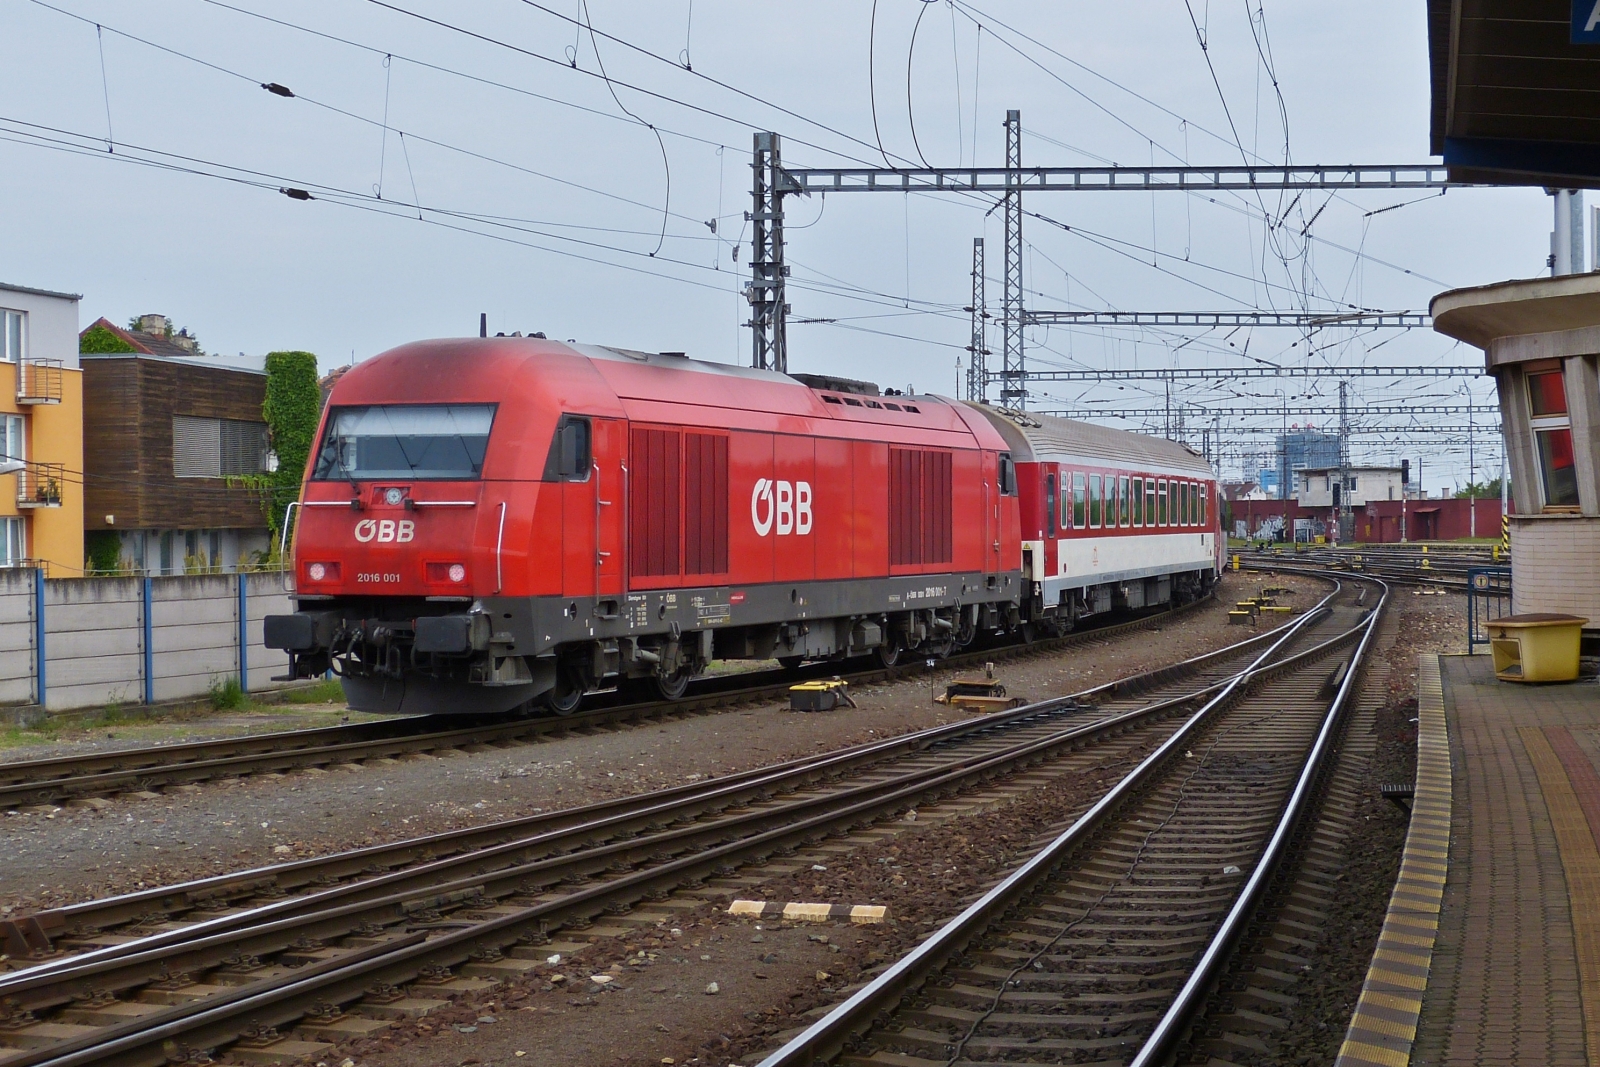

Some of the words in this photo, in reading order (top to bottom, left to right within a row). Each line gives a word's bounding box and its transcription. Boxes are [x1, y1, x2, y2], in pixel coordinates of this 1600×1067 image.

[750, 478, 813, 537] ÖBB
[354, 519, 415, 543] ÖBB
[357, 573, 380, 583] 2016
[383, 573, 400, 583] 001
